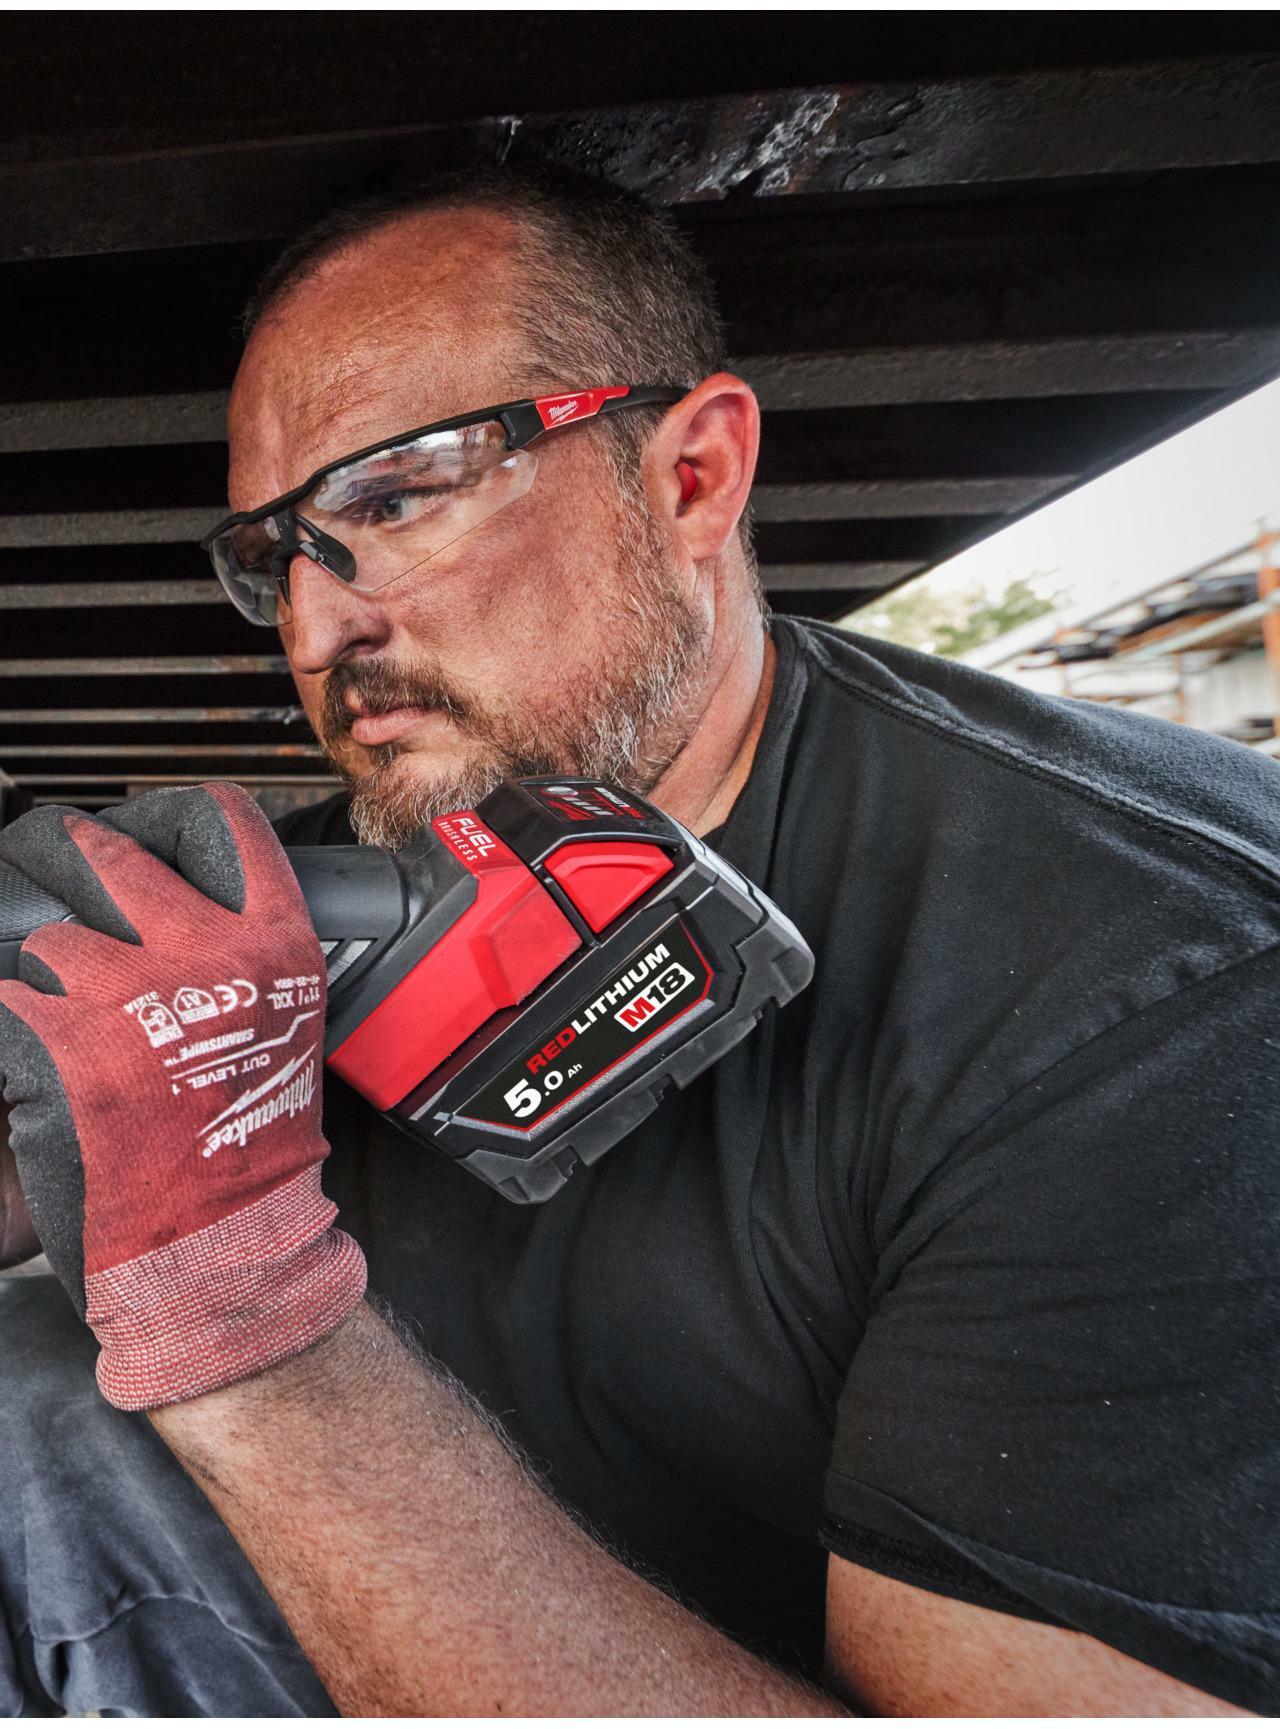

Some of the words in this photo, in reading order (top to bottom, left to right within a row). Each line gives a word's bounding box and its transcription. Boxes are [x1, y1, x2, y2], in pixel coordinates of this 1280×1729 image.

[438, 821, 478, 861] BRUSHLESS
[452, 818, 496, 857] FUEL
[526, 943, 671, 1076] REDLITHIUM
[618, 968, 690, 1029] M18
[186, 1065, 237, 1090] LEVEL
[241, 1054, 270, 1074] CUT
[172, 1083, 182, 1096] 1
[503, 1069, 564, 1119] 5.0
[566, 1063, 583, 1079] Ah
